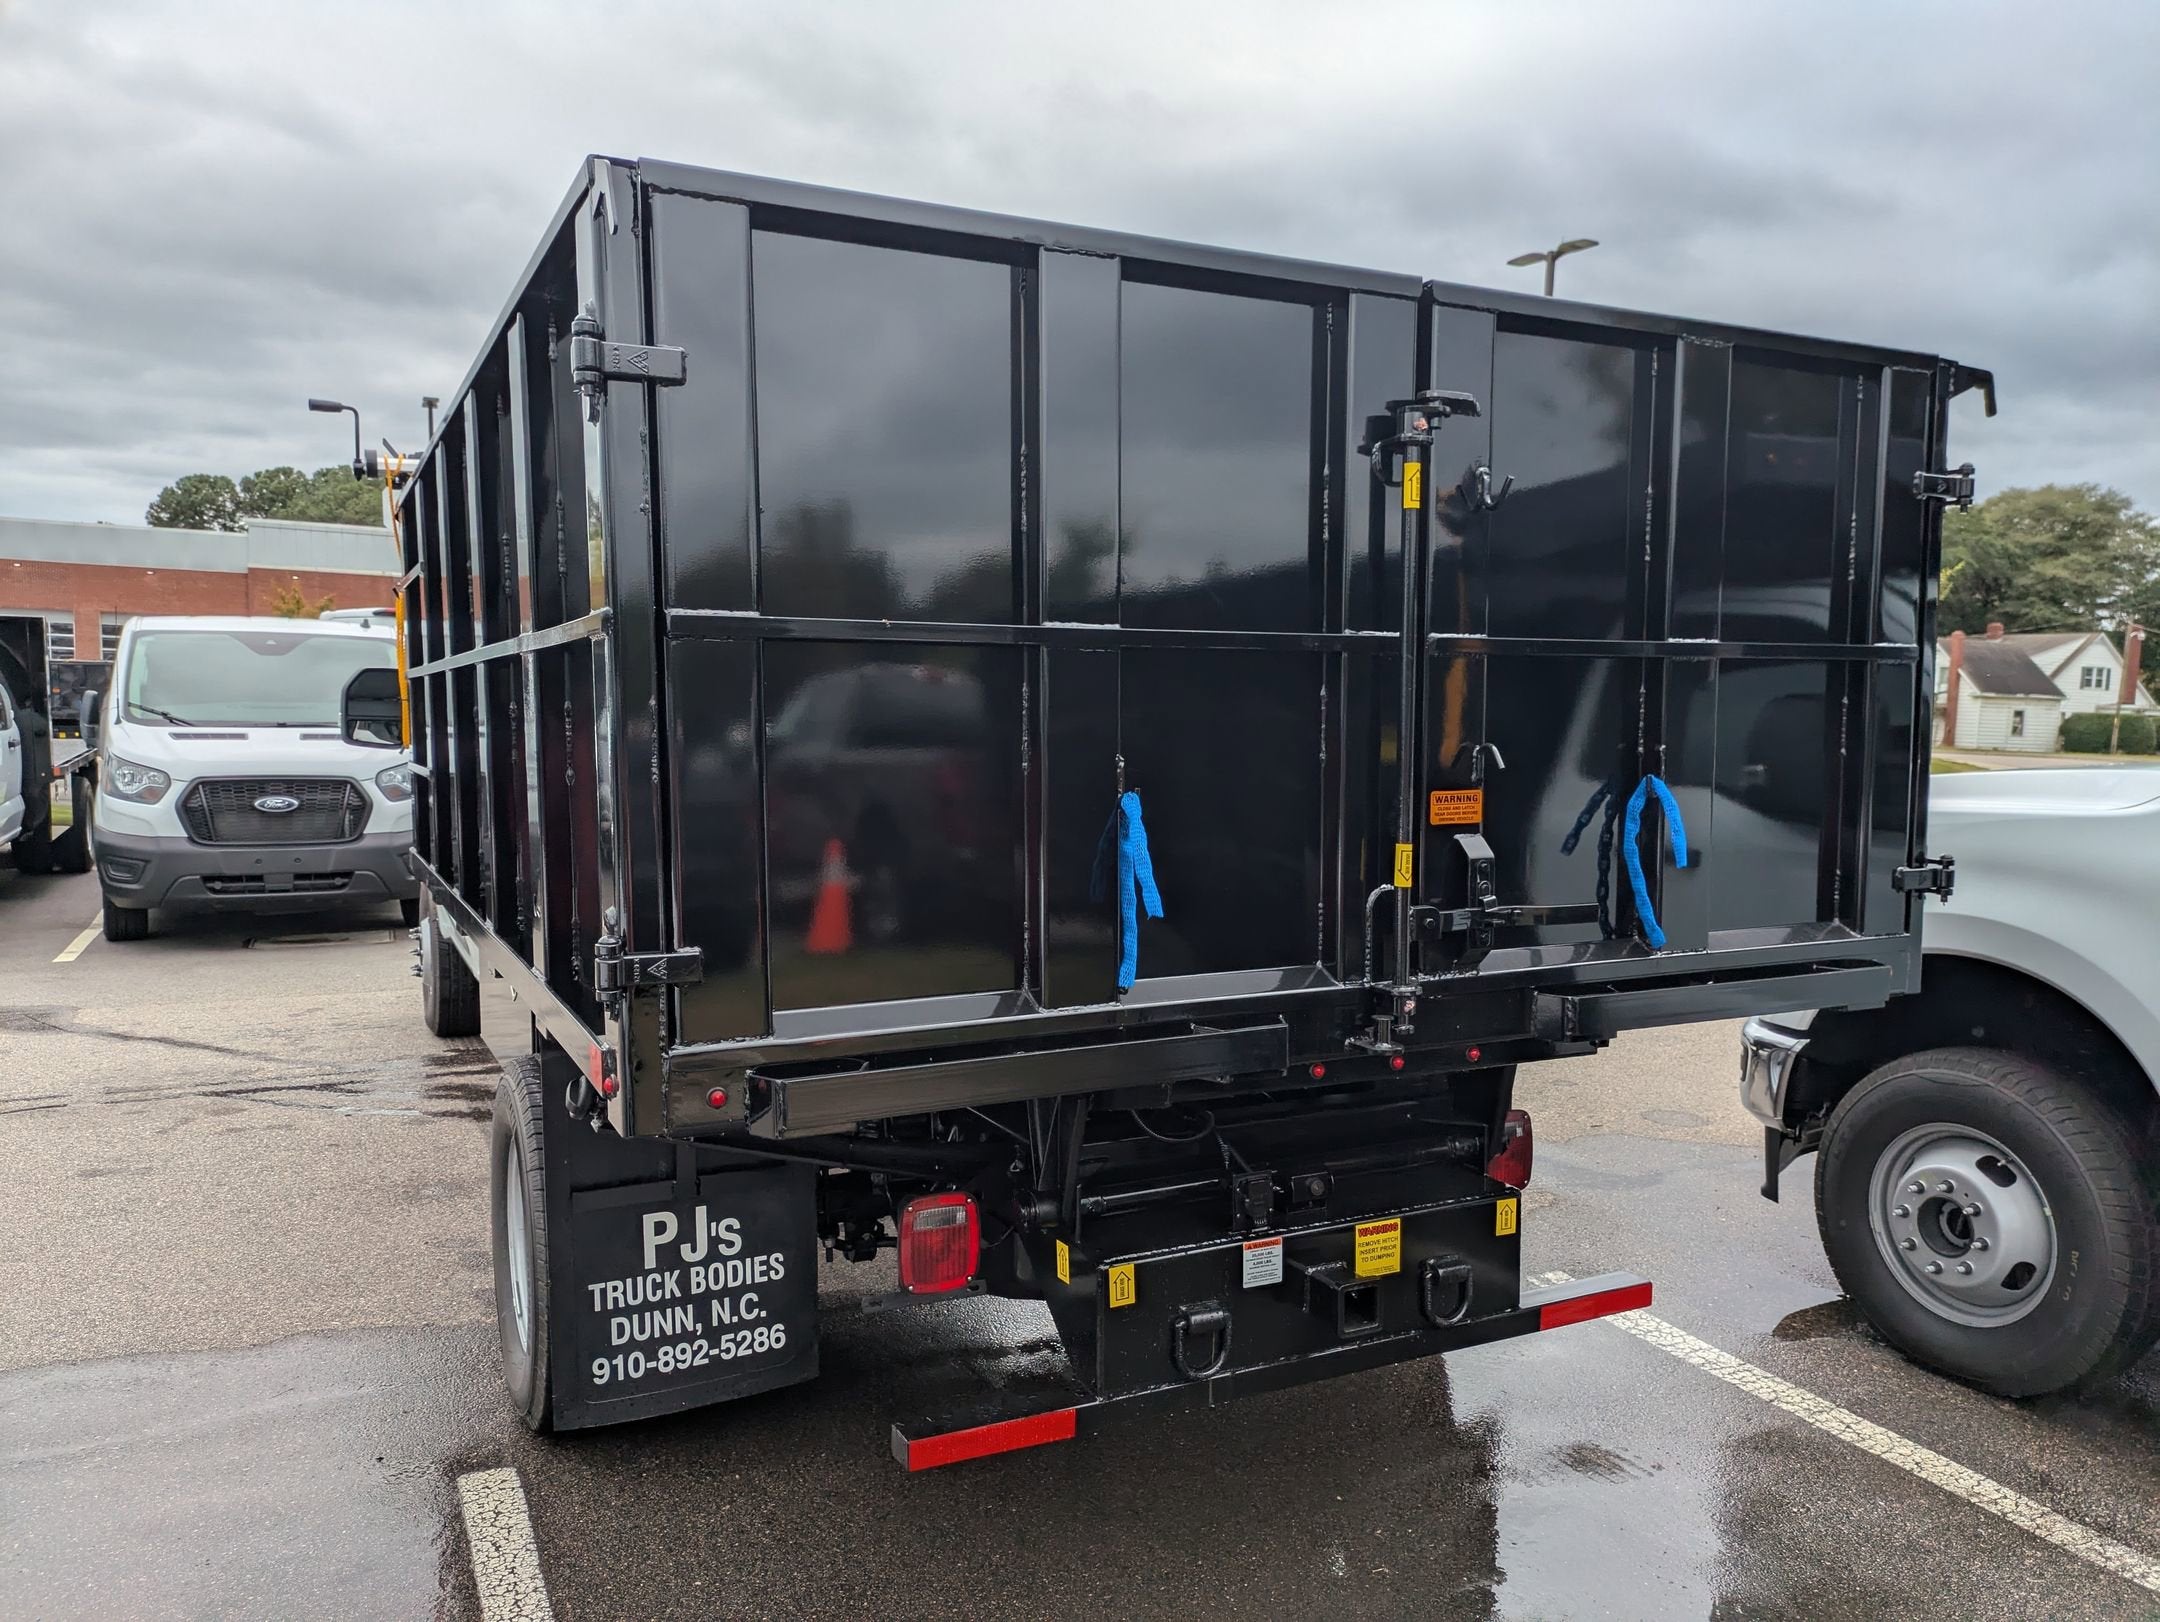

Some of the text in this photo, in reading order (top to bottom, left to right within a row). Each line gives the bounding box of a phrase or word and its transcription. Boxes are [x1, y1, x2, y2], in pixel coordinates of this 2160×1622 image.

[1434, 794, 1478, 804] WARNING
[1358, 1222, 1399, 1238] WARNING
[1253, 1239, 1280, 1248] WARNING
[1358, 1236, 1399, 1248] REMOVE HITCH
[1359, 1244, 1397, 1257] INSERT PRIOR
[1370, 1251, 1395, 1262] DUMPING
[587, 1252, 785, 1312] TRUCK BODIES
[610, 1292, 767, 1346] DUNN, N.C.
[591, 1323, 787, 1386] 910-892-5286
